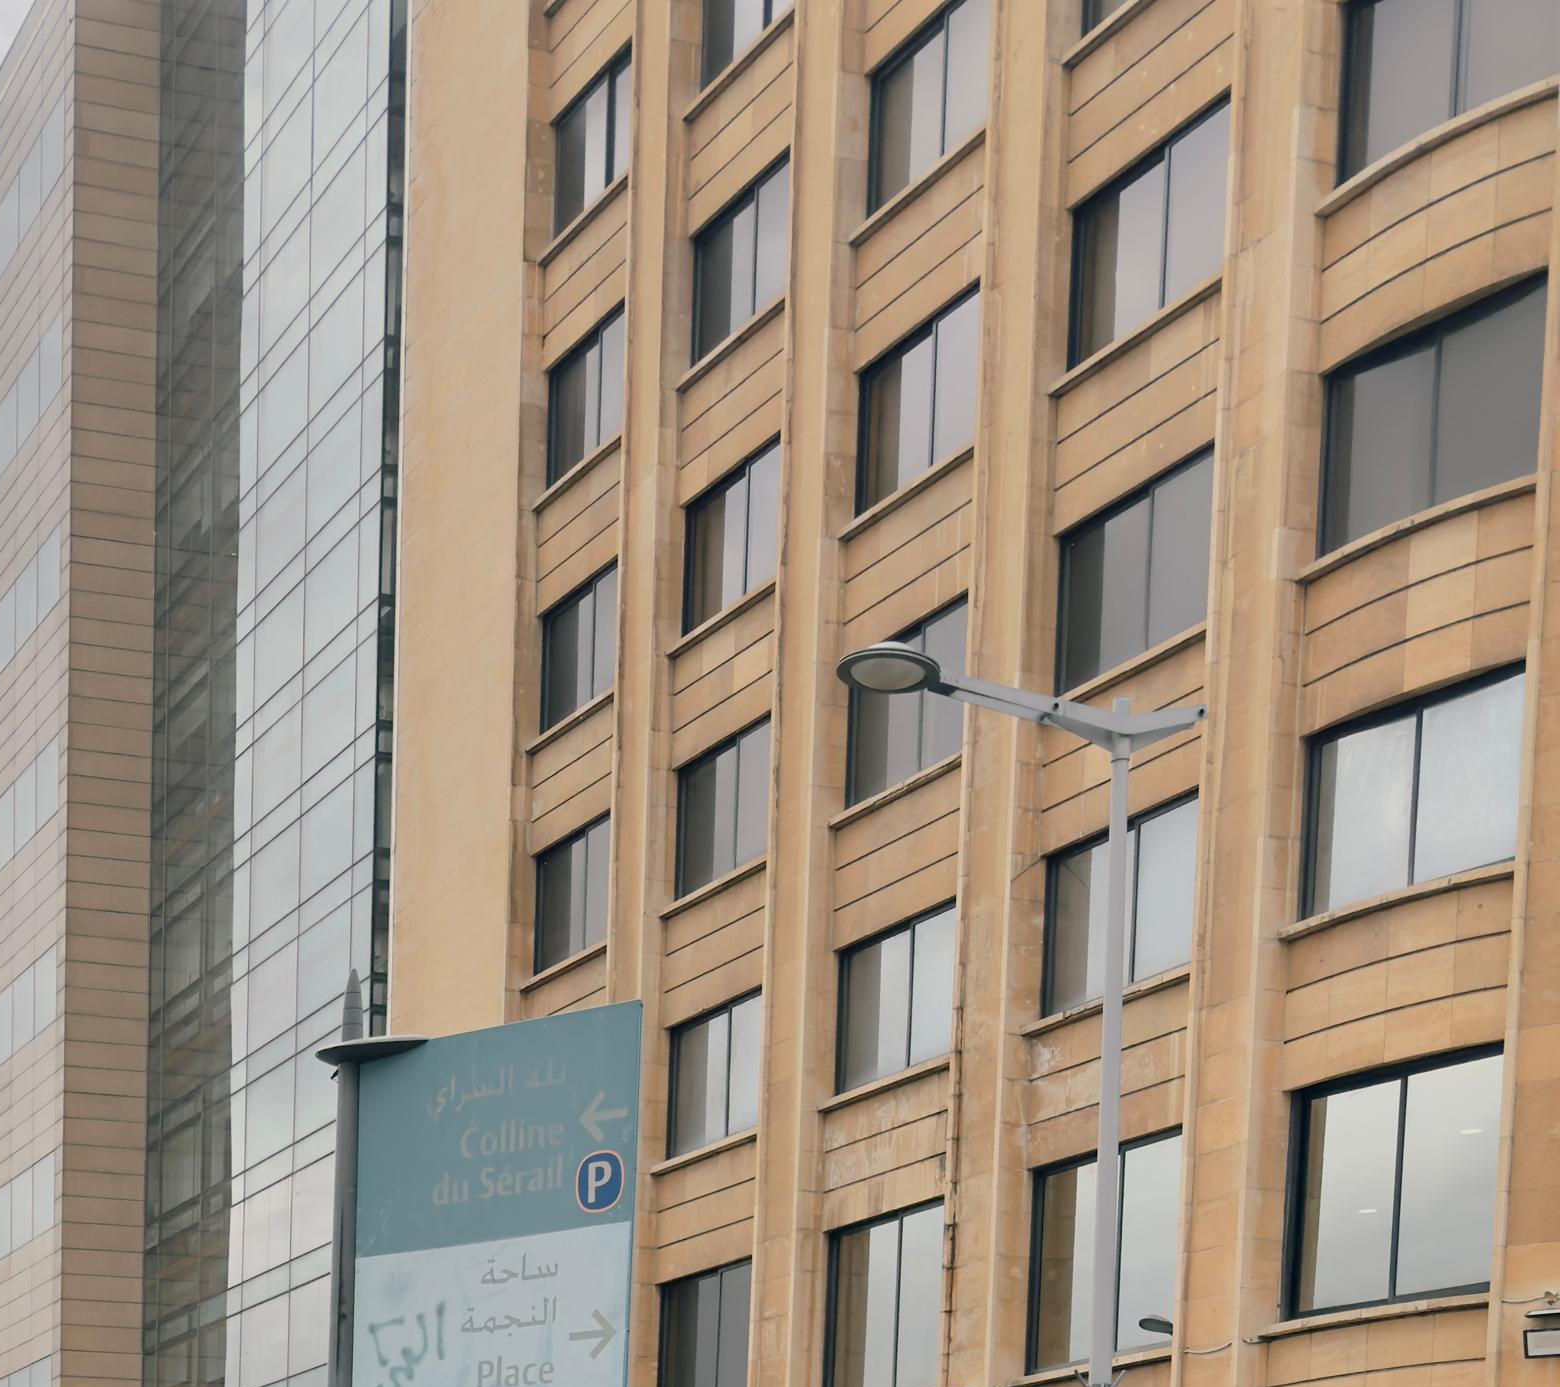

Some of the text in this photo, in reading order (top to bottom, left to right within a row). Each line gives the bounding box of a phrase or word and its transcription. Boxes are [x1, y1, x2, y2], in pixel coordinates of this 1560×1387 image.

[460, 1118, 565, 1160] Colline
[432, 1153, 565, 1206] du Sérail
[588, 1161, 611, 1203] P
[480, 1253, 559, 1285] ساحة
[460, 1296, 557, 1338] النجمة
